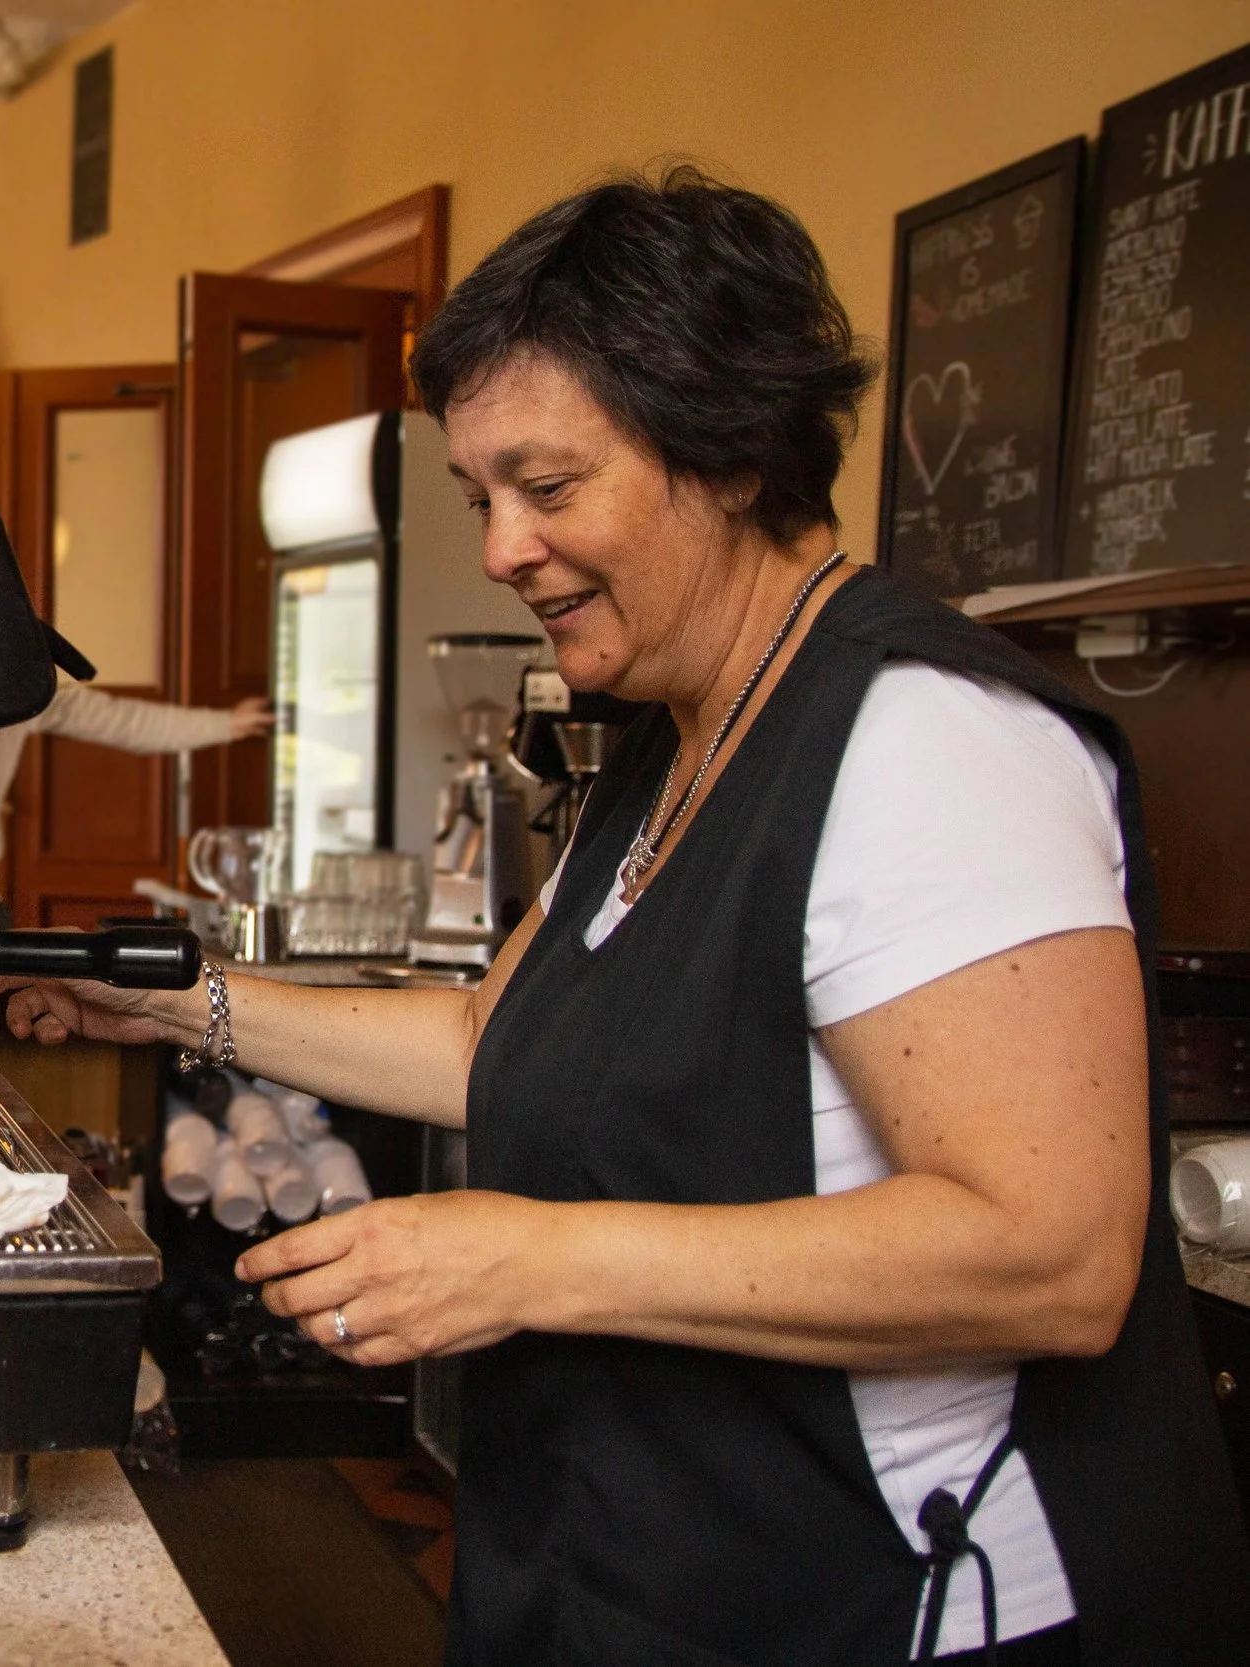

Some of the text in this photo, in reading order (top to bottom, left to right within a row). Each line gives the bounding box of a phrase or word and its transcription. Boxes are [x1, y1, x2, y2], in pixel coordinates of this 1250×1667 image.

[1162, 82, 1250, 179] KAFF
[1104, 215, 1186, 268] AMERICANO
[1100, 249, 1182, 301] ESPRESSO
[1097, 281, 1172, 330] CORTADO
[1097, 306, 1192, 359] CAPPUCCINO
[1091, 369, 1184, 418] MACCHIATO
[1094, 353, 1141, 391] LATTE
[1143, 402, 1193, 444] LATTE
[1173, 430, 1218, 470] LATTE
